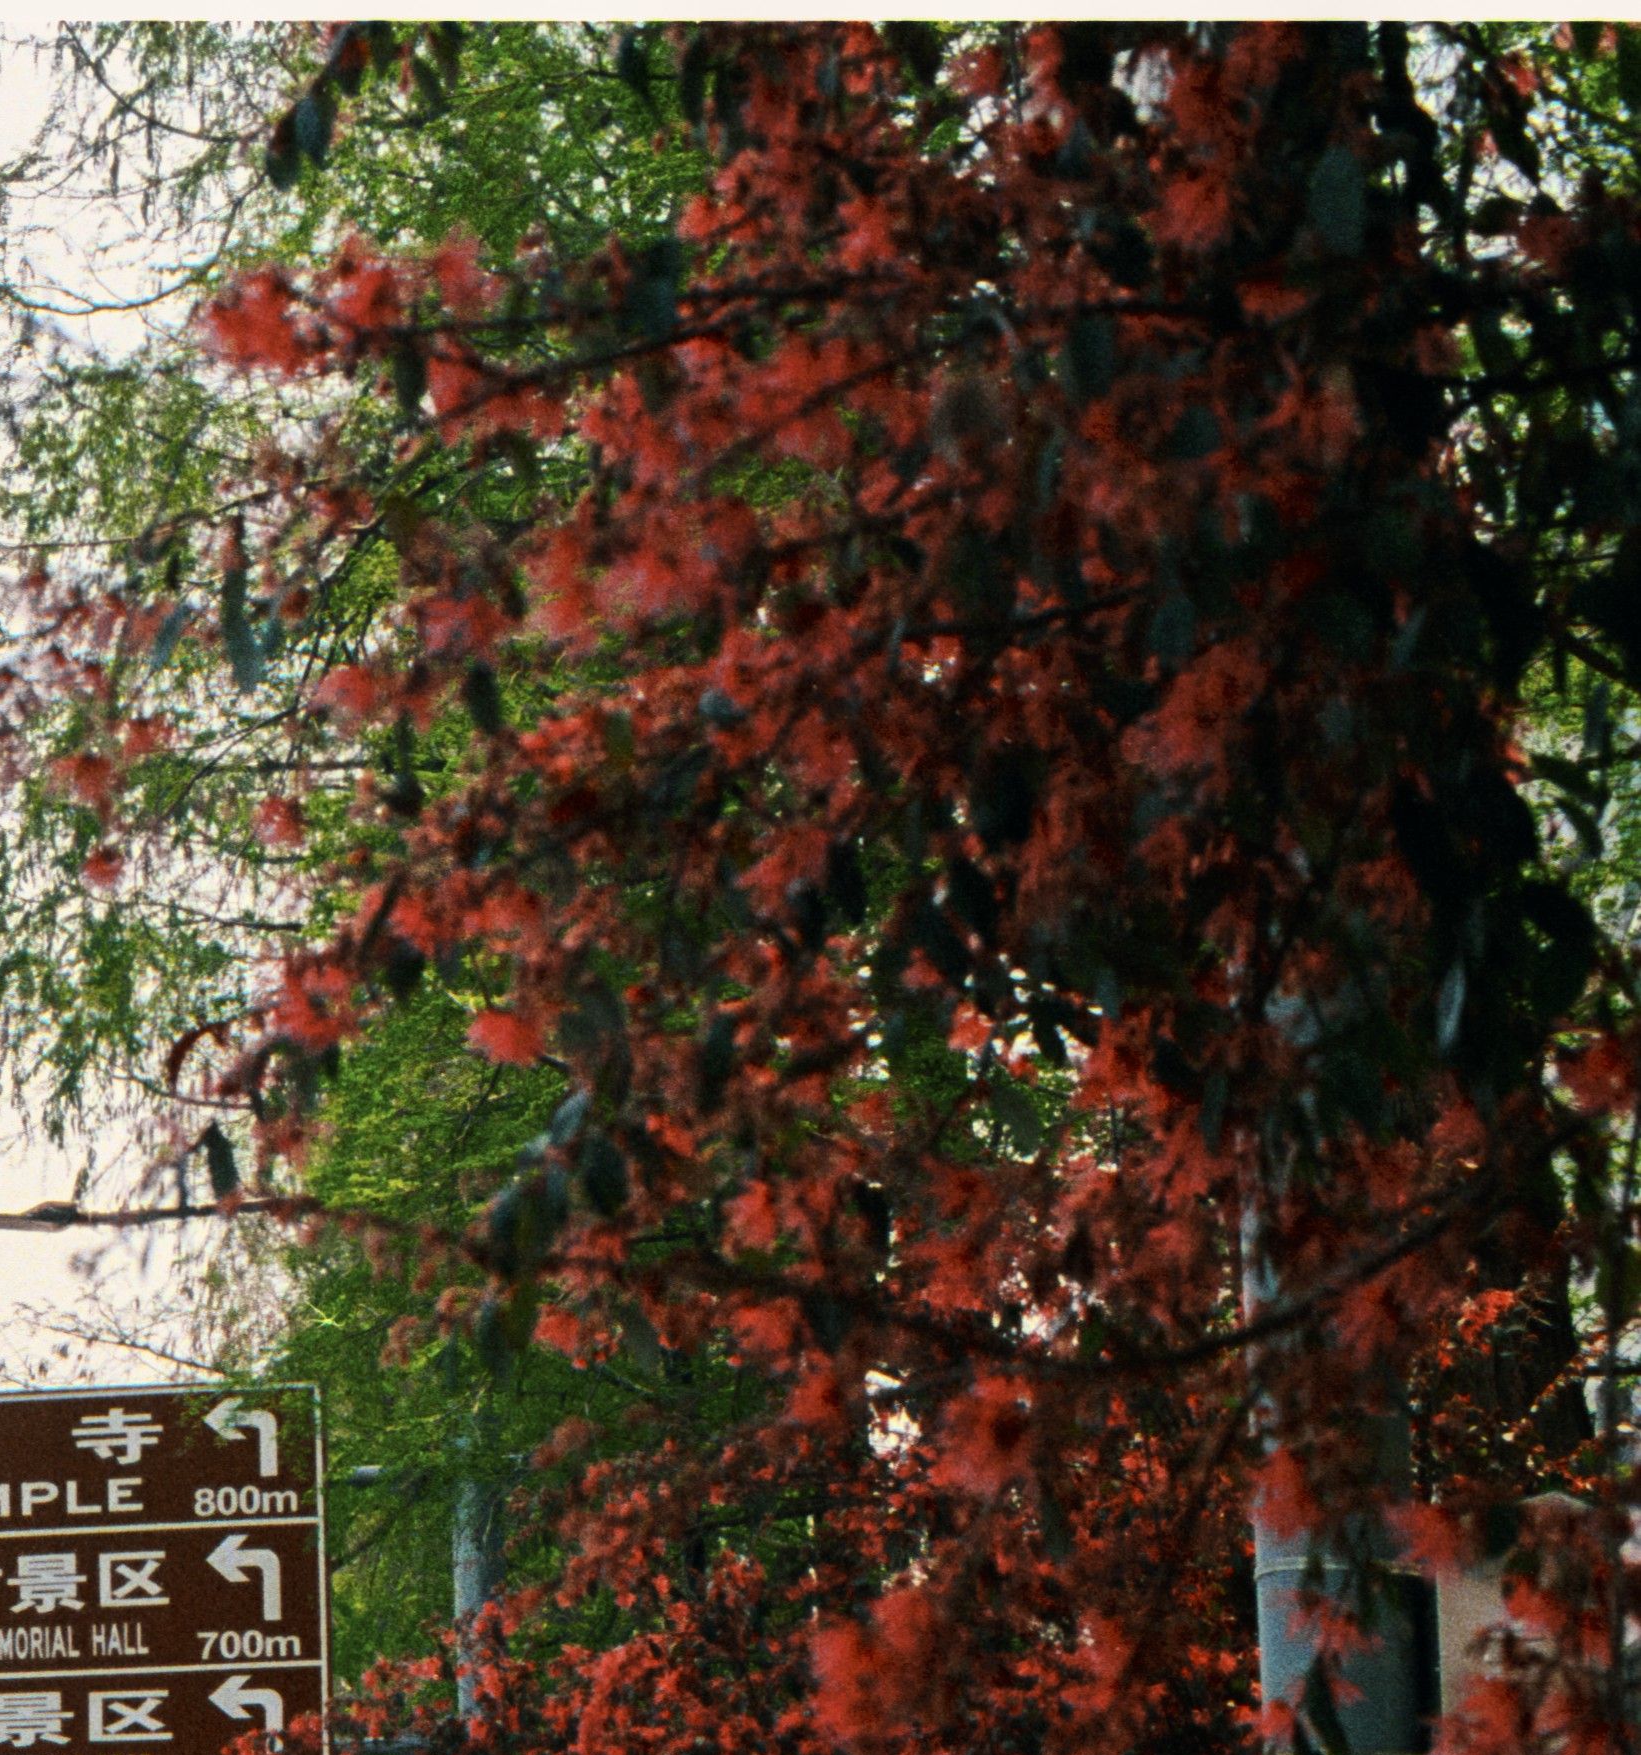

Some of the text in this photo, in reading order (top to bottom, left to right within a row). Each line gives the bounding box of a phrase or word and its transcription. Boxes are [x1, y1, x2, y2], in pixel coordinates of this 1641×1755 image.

[193, 1485, 298, 1517] 800m
[91, 1622, 150, 1656] HALL
[196, 1629, 302, 1661] 700m
